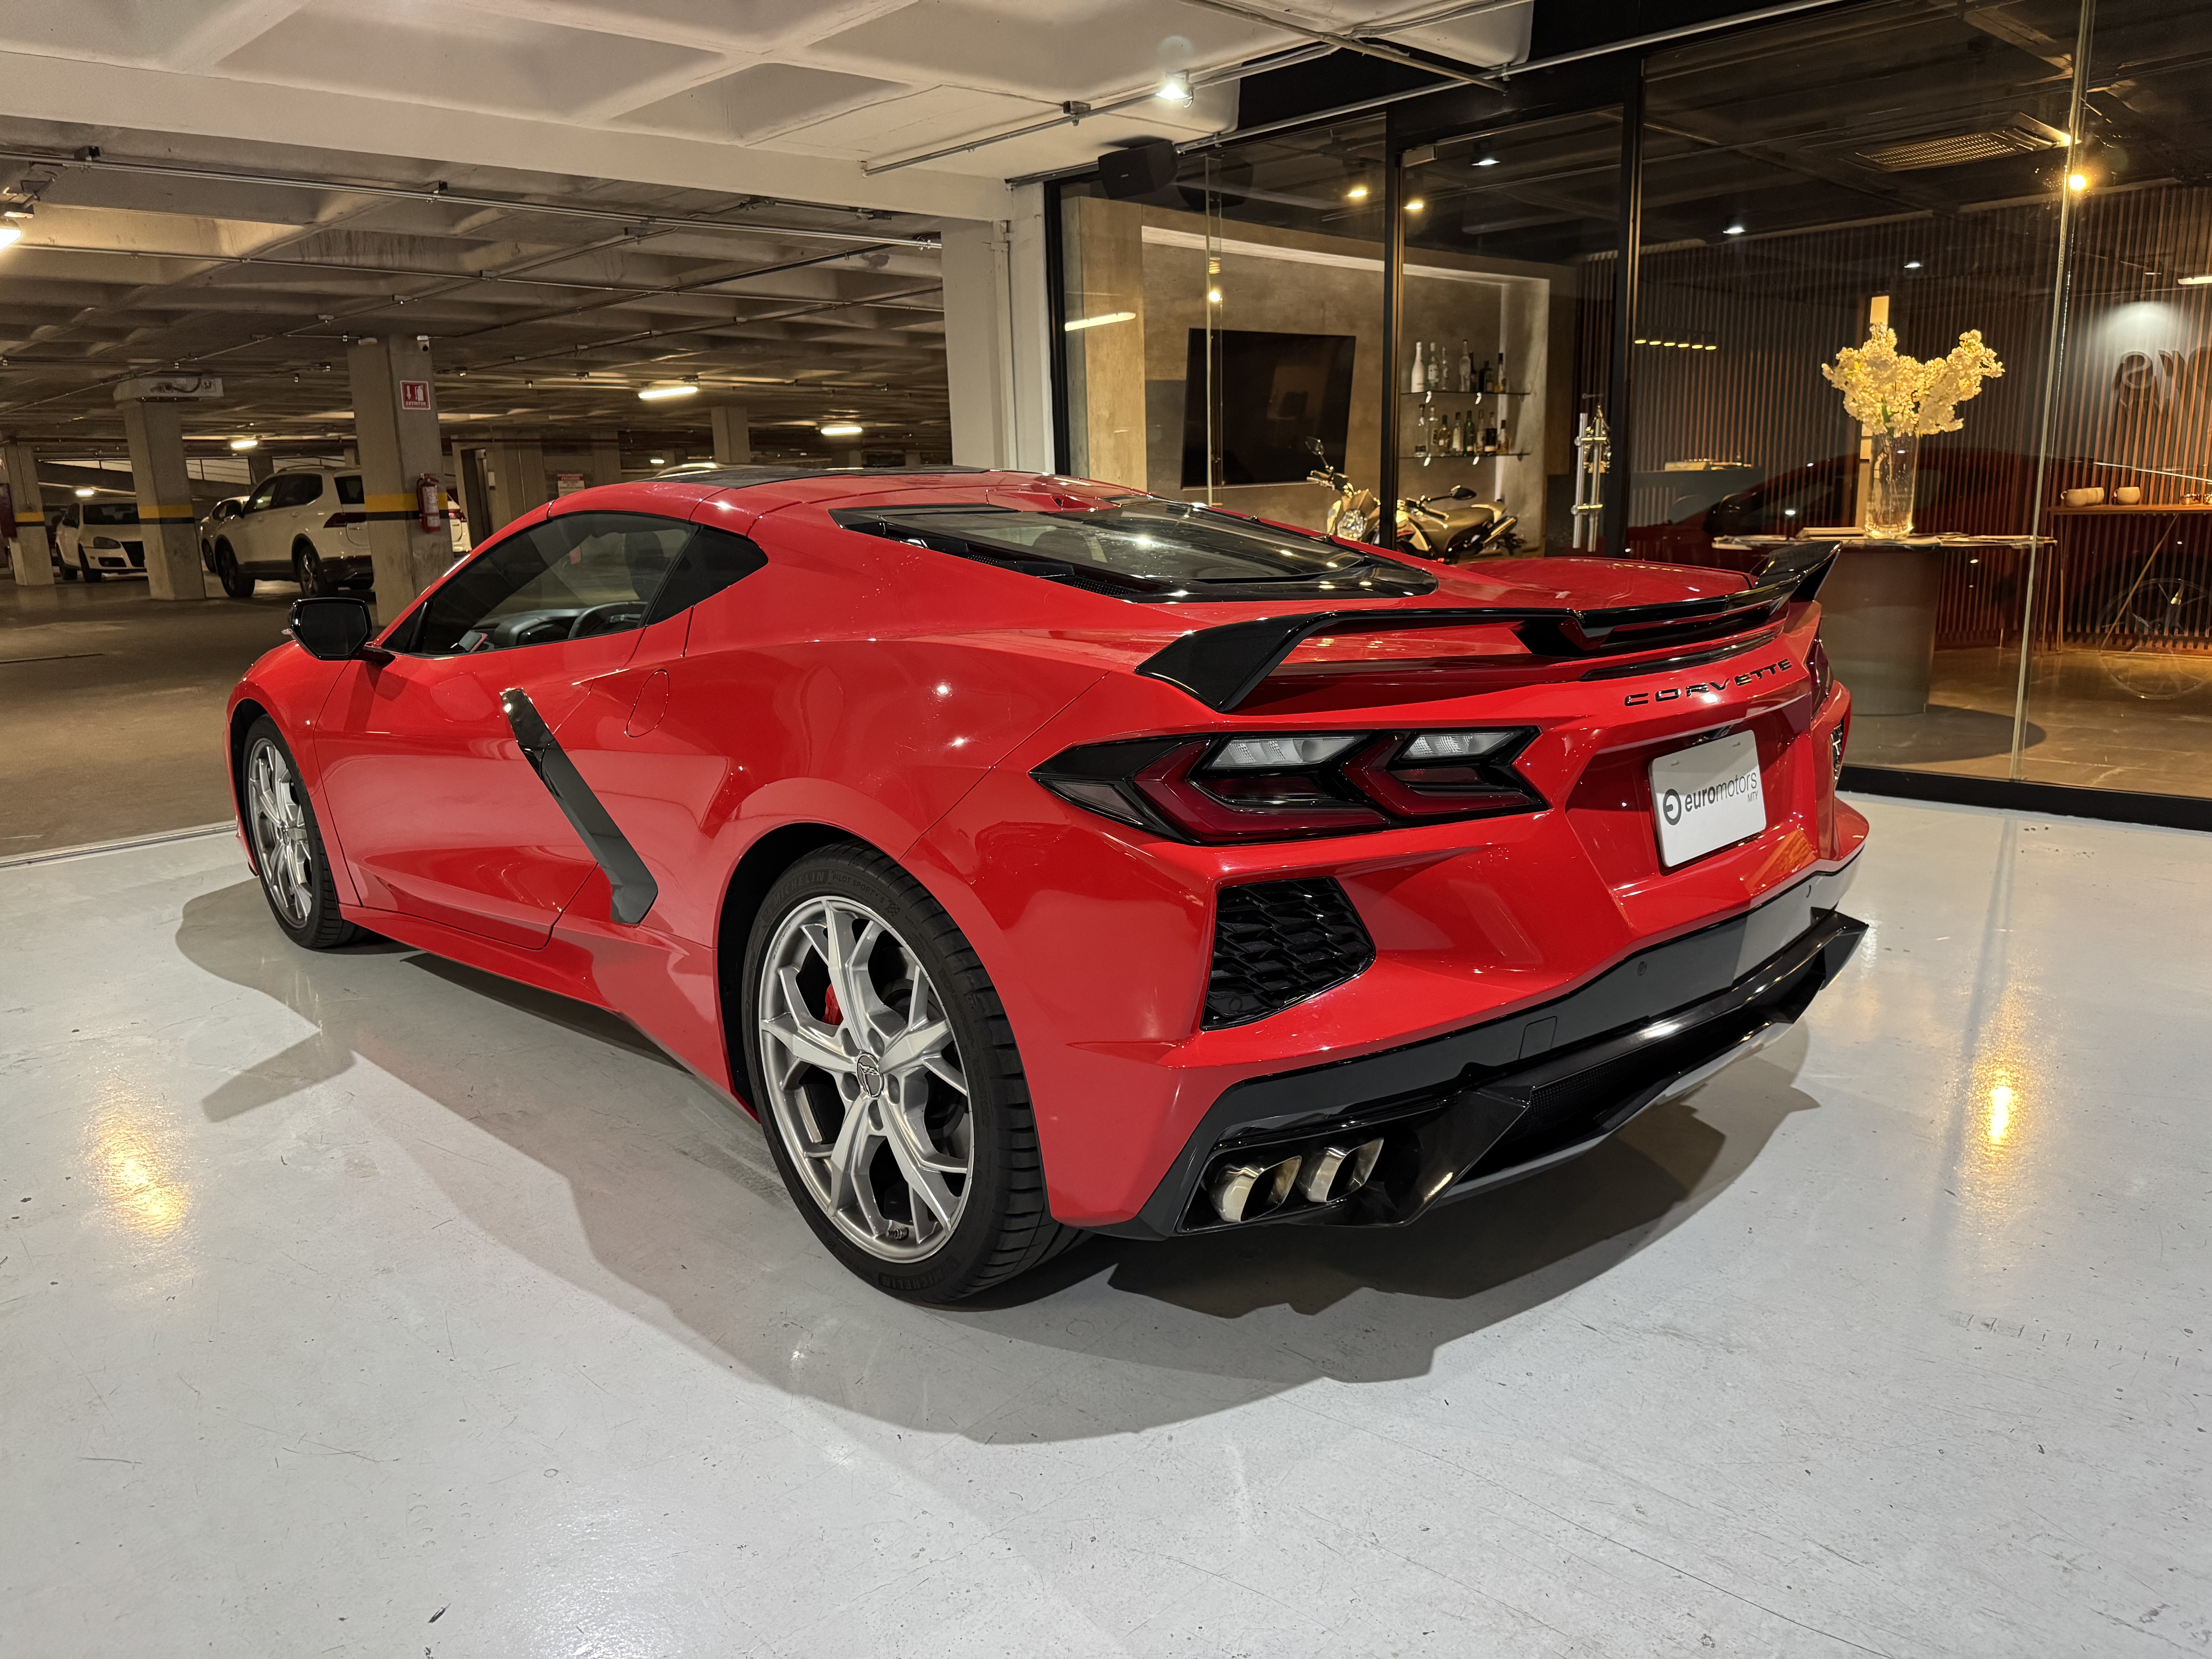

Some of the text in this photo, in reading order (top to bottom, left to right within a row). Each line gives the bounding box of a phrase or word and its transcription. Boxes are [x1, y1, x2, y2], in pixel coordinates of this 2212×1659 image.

[1624, 658, 1793, 707] CORVETTE
[1685, 772, 1757, 812] euromotors
[1748, 790, 1758, 803] MTY
[773, 871, 824, 907] MICHELIN
[832, 873, 851, 883] PILOT
[853, 880, 875, 895] SPORT
